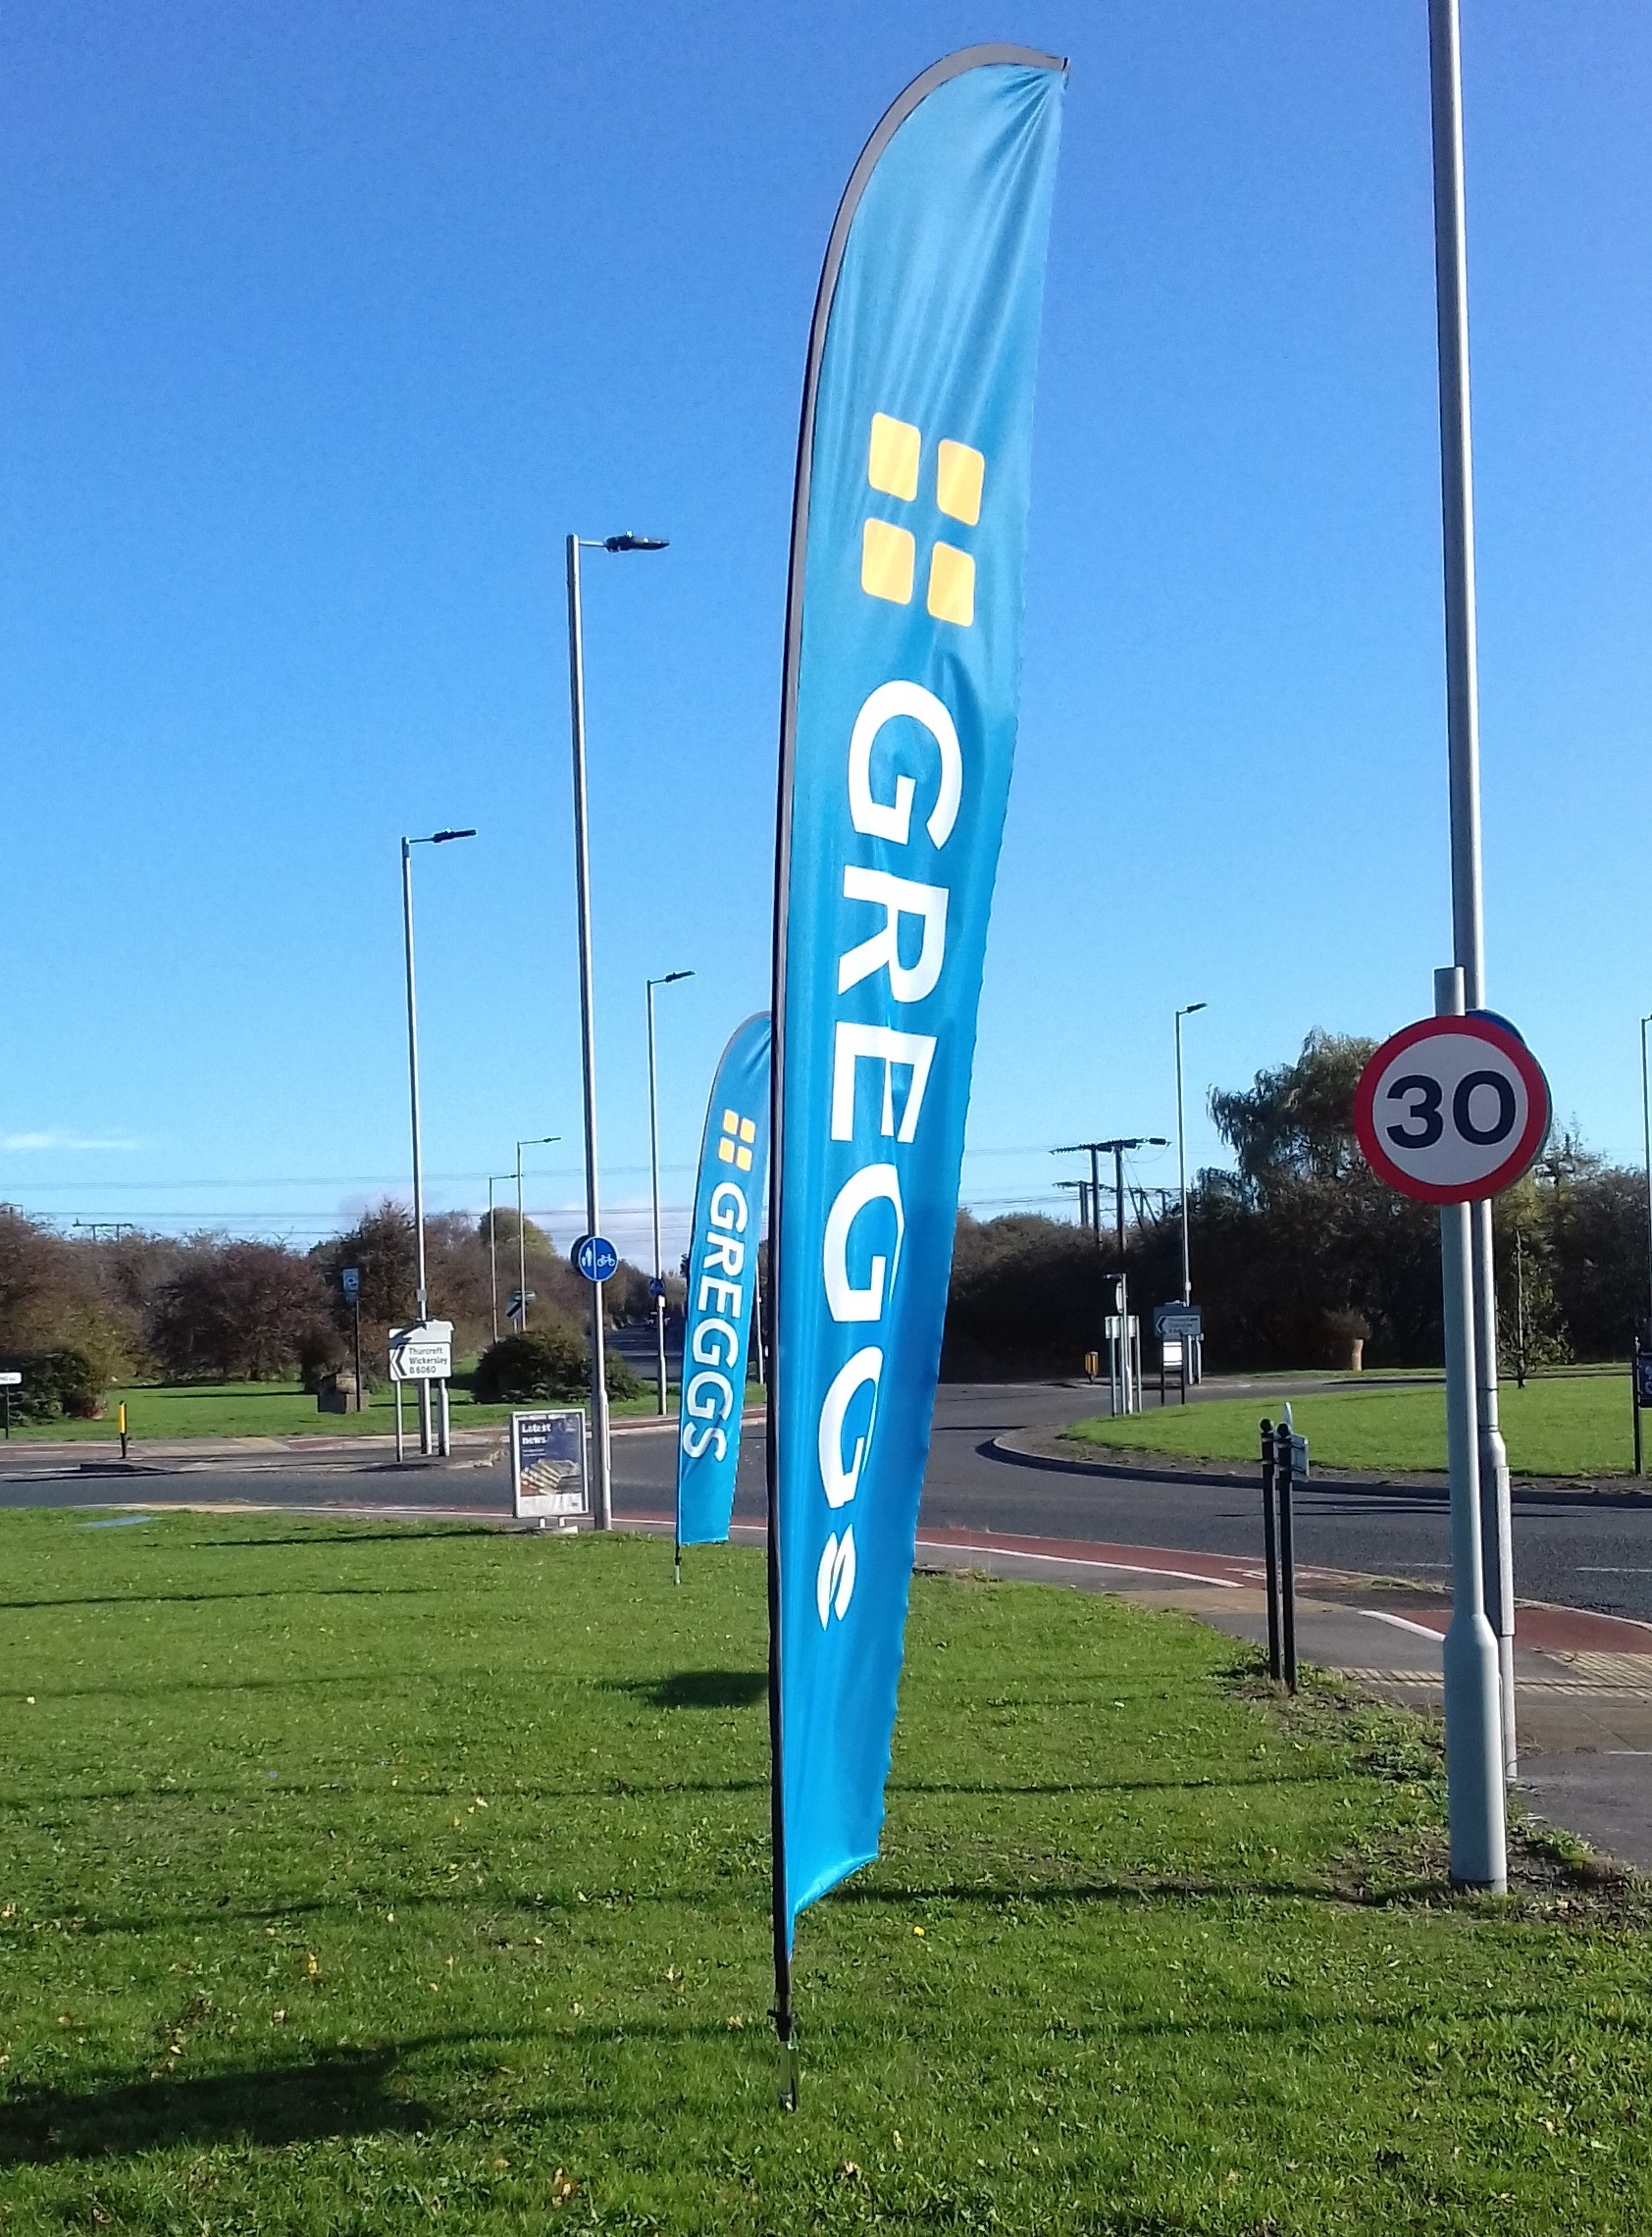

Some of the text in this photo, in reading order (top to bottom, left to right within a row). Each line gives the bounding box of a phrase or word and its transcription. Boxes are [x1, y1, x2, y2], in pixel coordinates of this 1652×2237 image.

[1386, 1070, 1516, 1148] 30
[816, 679, 962, 1632] GREGGS
[408, 1356, 447, 1365] Wickersley
[683, 1181, 749, 1462] GREGGS
[521, 1423, 551, 1432] Latest
